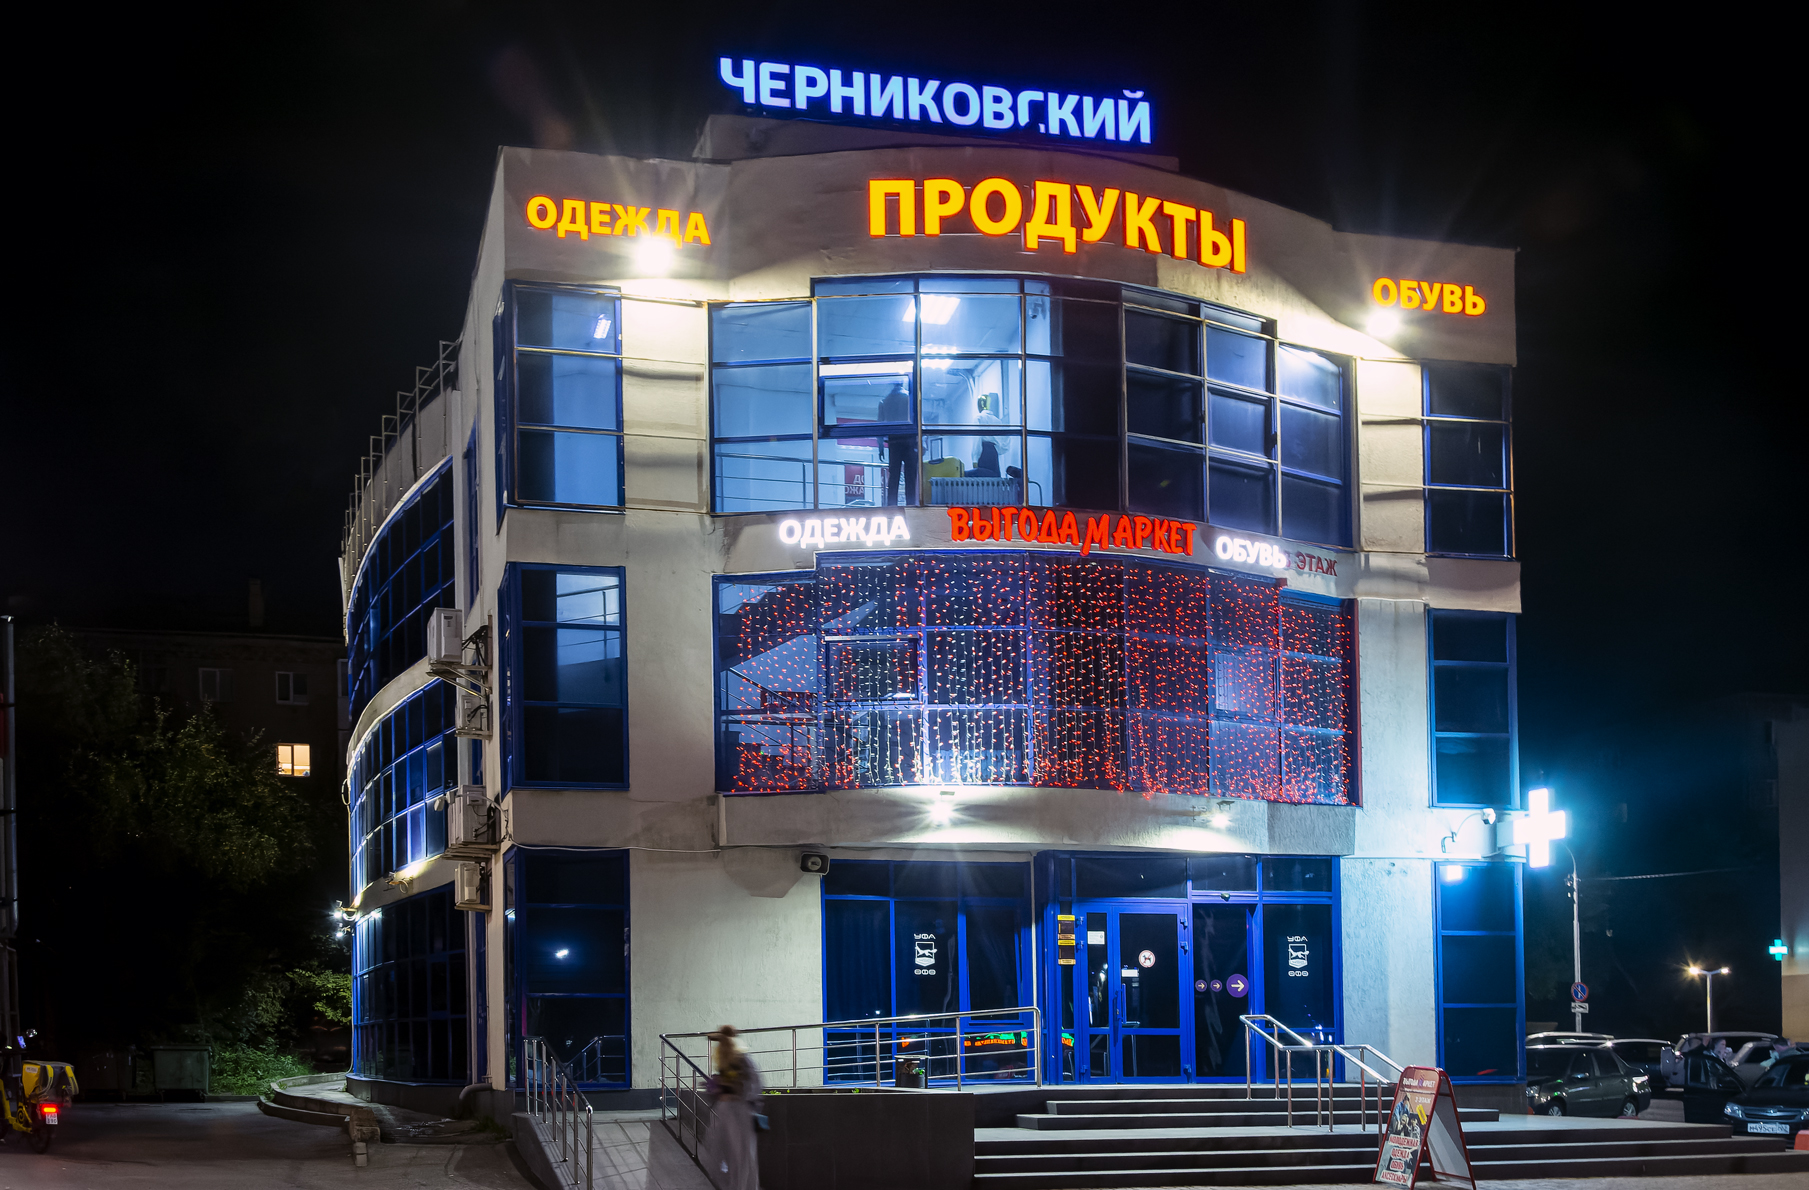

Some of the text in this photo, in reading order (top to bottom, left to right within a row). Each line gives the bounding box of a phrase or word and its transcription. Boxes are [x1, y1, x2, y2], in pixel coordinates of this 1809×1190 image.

[719, 57, 1152, 144] ЧЕРНИКОВСКИЙ
[526, 194, 712, 250] ОДЕЖДА
[868, 177, 1246, 274] ПРОДУКТЫ
[1372, 276, 1487, 317] ОБУВЬ
[778, 515, 911, 549] ОДЕЖДА
[947, 507, 1198, 556] ВЫГОДА МАРКЕТ
[1215, 535, 1288, 569] ОБУВЬ
[1295, 551, 1338, 577] ЭТАЖ
